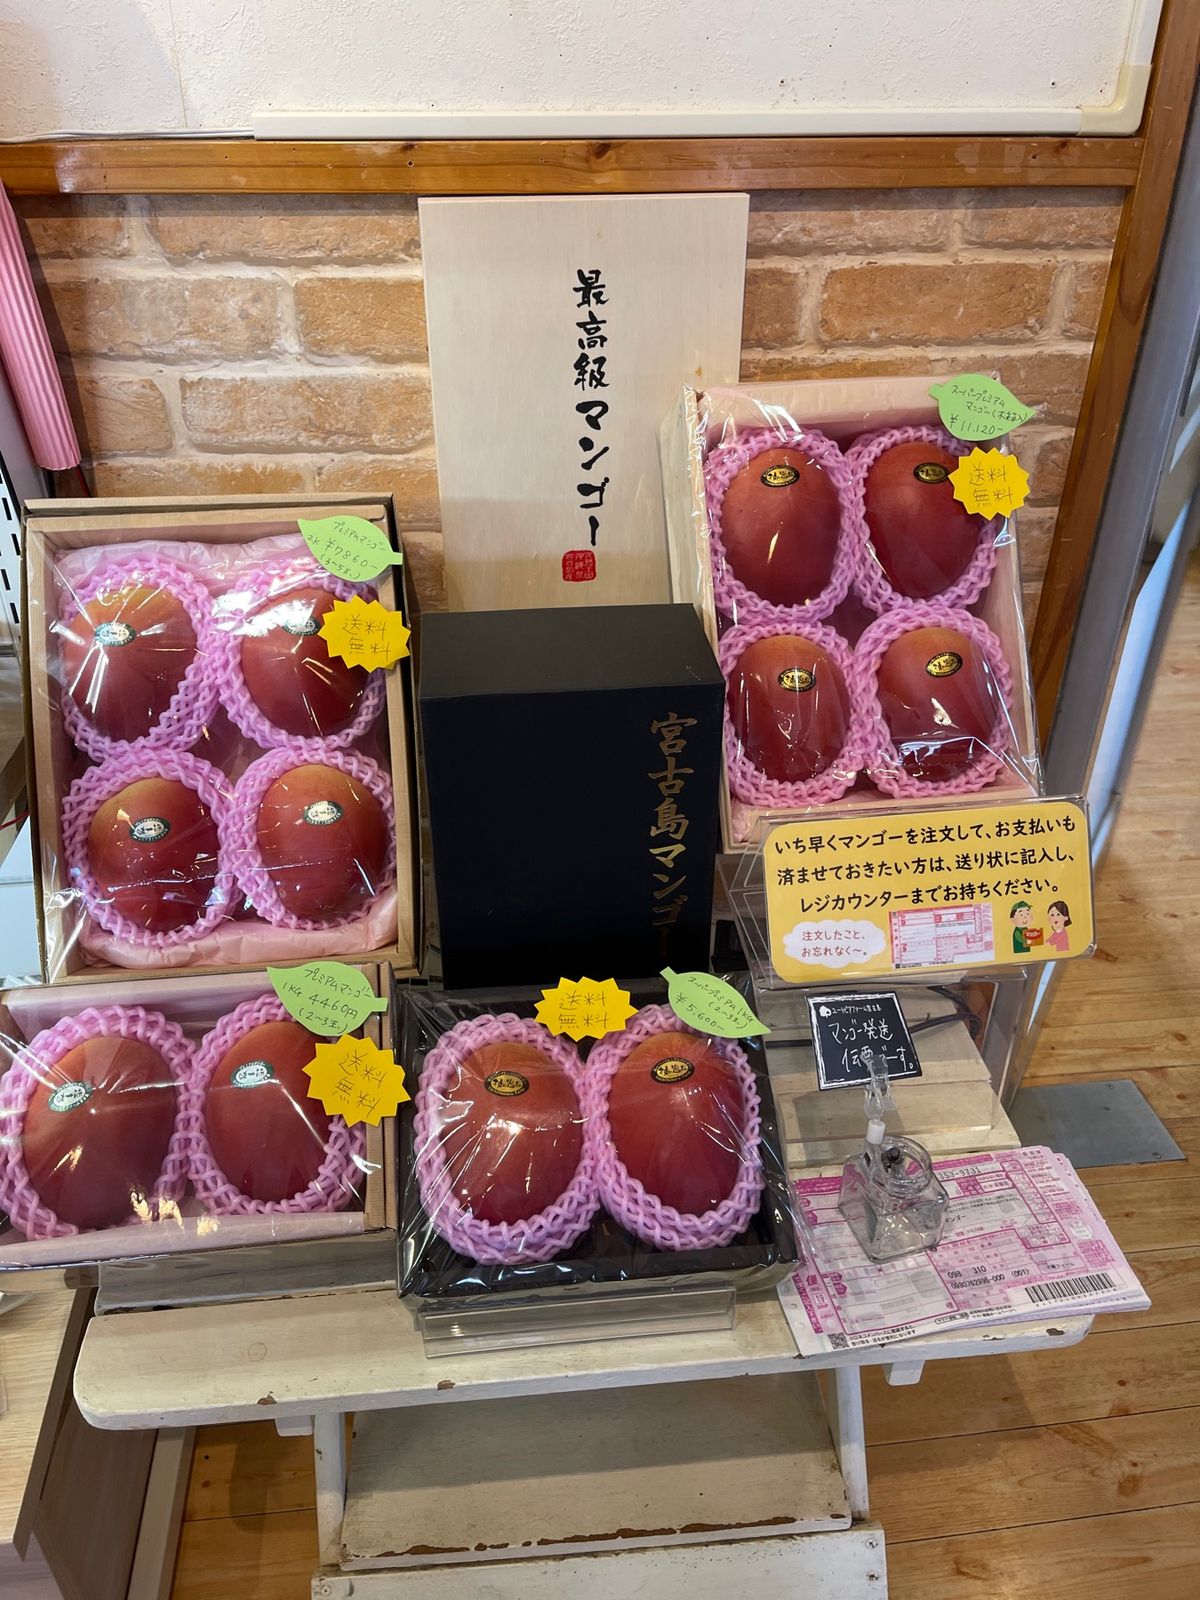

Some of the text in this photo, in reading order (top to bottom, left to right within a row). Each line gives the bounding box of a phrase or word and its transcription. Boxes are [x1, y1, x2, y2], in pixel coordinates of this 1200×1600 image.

[572, 268, 610, 547] 最高級マンゴー
[969, 462, 1007, 486] 送料
[973, 486, 1013, 508] 無料
[333, 521, 386, 551] プレミアムマンゴー
[342, 612, 387, 641] 送料
[348, 636, 392, 661] 無料
[648, 712, 698, 958] 宮古島マンゴー
[775, 815, 1076, 856] いち早くマンゴーを注文して、お支払いも
[777, 845, 1075, 886] 済ませておきたい方は、送り状に記入し、
[800, 877, 1060, 913] レジカウンターまでお持ちください。
[801, 929, 866, 941] 注文したこと、
[304, 968, 372, 998] プレミアムマンゴー
[308, 994, 358, 1020] 4460円
[558, 989, 607, 1011] 送料
[558, 1011, 610, 1030] 無料
[828, 1018, 894, 1045] マンゴー発送
[338, 1050, 388, 1089] 送料
[331, 1076, 382, 1119] 無料
[973, 1265, 987, 1275] 310
